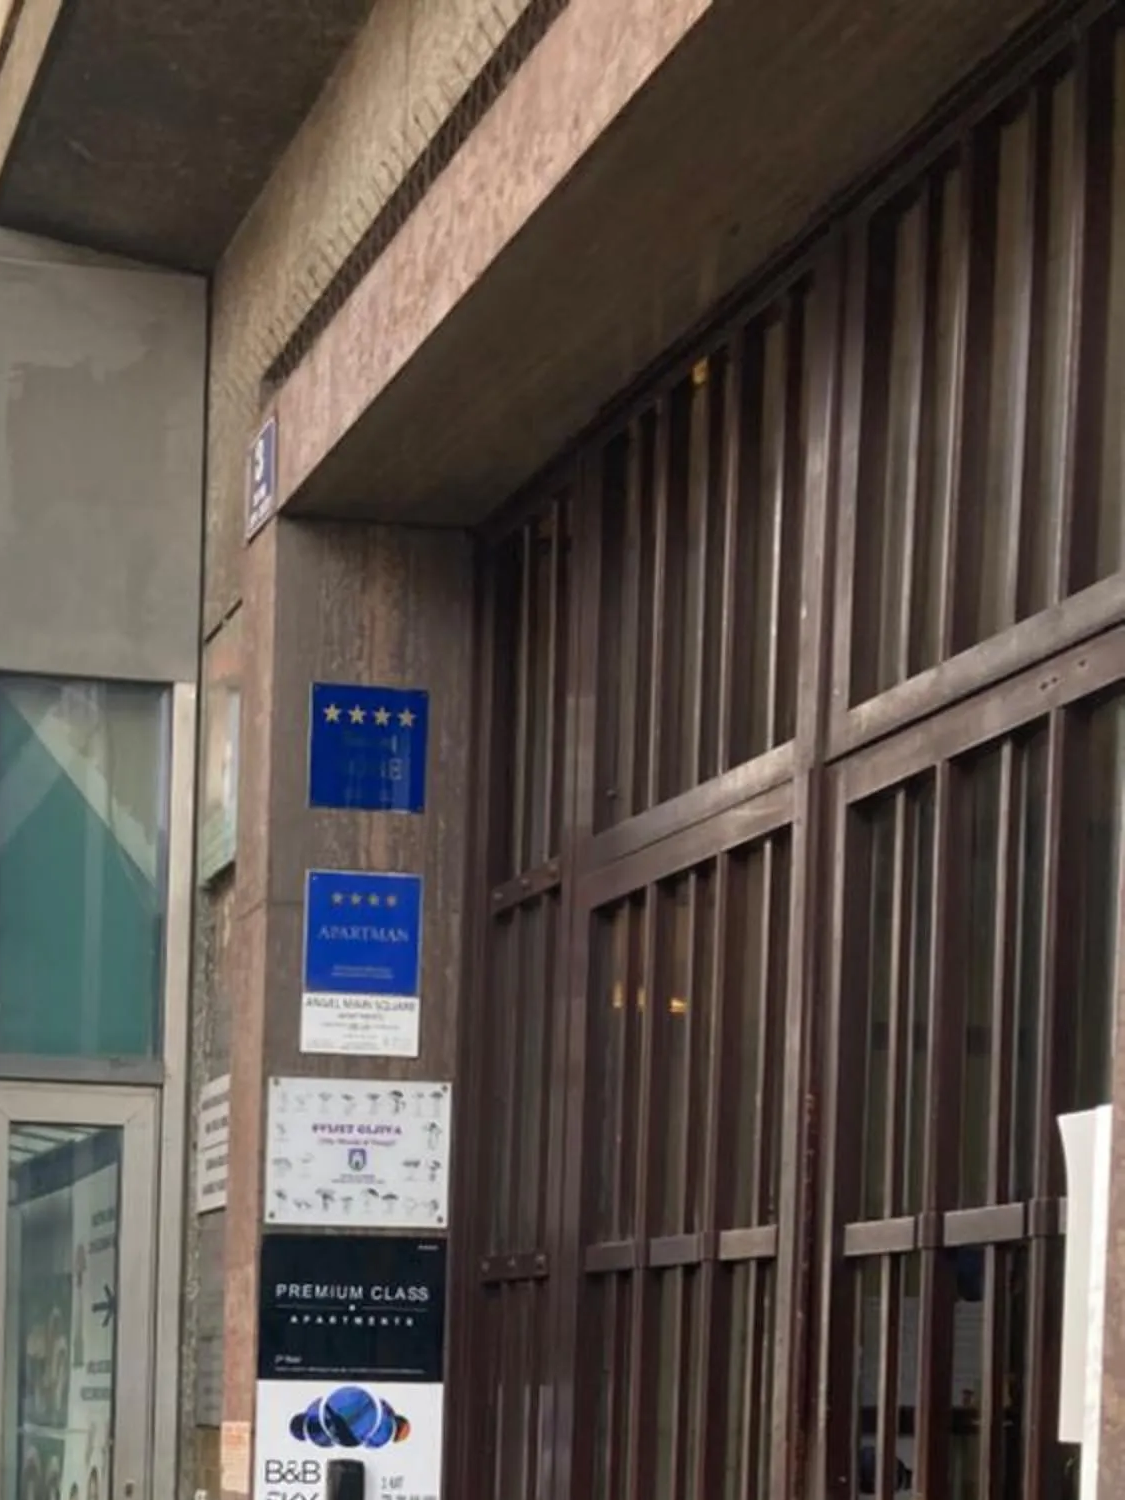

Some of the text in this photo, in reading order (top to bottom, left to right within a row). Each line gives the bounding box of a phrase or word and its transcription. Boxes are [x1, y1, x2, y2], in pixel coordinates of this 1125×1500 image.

[317, 924, 410, 943] APARTMAN
[275, 1283, 430, 1302] PREMIUM CLASS
[290, 1314, 414, 1327] APARTMENTS
[264, 1458, 321, 1485] B&B
